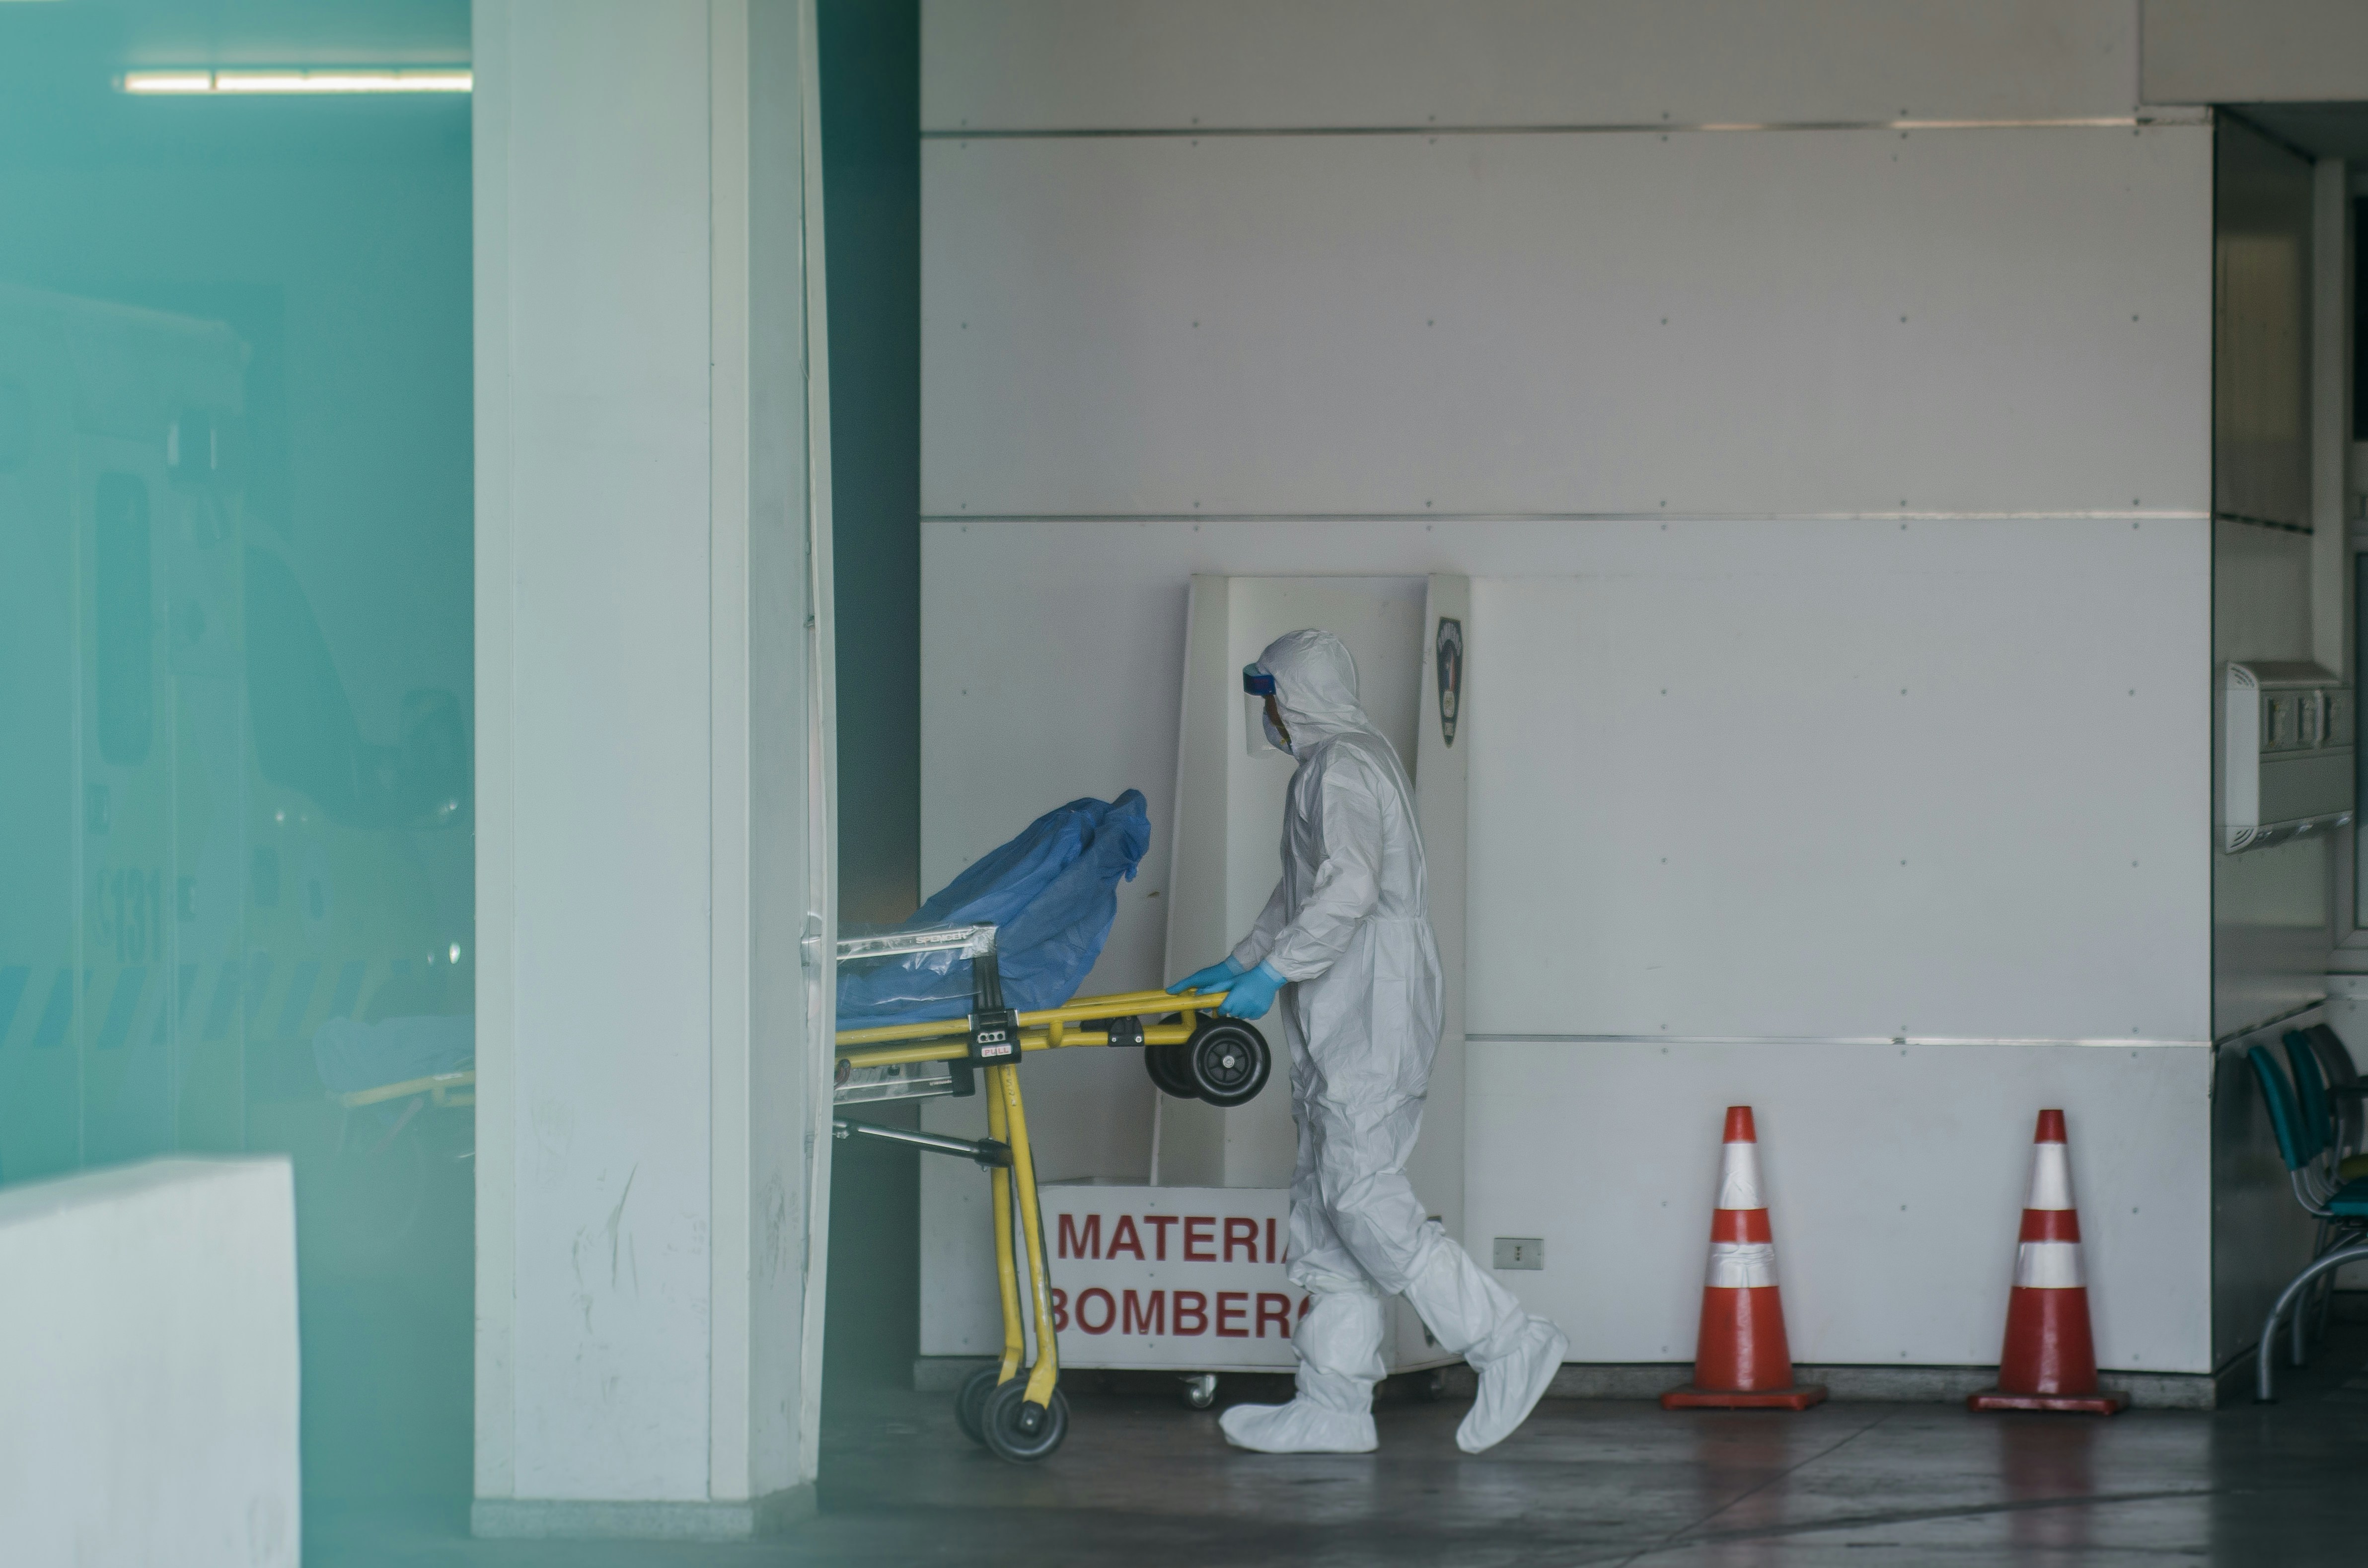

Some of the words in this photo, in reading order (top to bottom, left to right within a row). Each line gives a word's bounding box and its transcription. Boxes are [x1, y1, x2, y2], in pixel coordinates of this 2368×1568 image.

[916, 933, 966, 944] SPENCER
[984, 1047, 1009, 1056] PULL
[1058, 1213, 1288, 1264] MATERI
[1050, 1287, 1310, 1339] BOMBER
